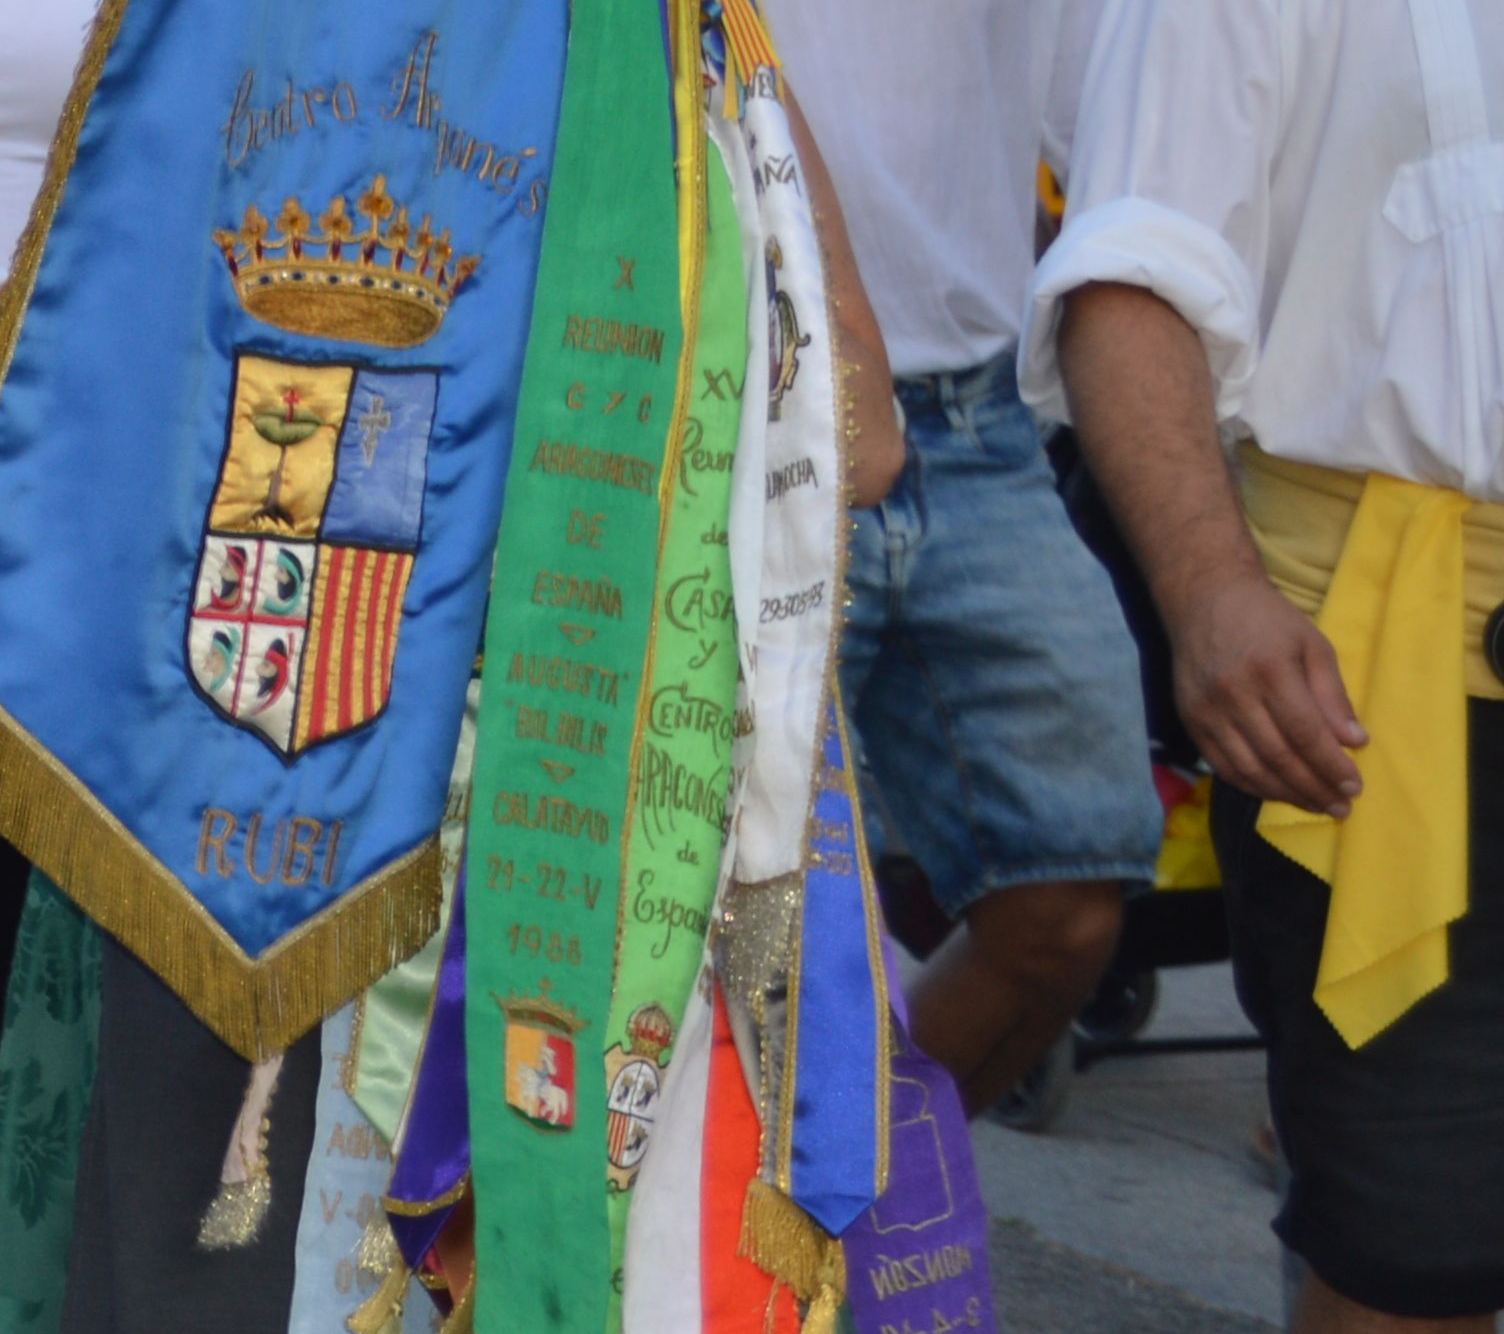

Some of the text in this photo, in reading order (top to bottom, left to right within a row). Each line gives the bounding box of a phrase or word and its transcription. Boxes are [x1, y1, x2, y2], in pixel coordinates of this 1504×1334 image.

[613, 255, 635, 291] X
[565, 382, 586, 411] C
[566, 510, 608, 549] DE
[530, 570, 623, 619] ESPAÑA
[677, 839, 700, 866] de
